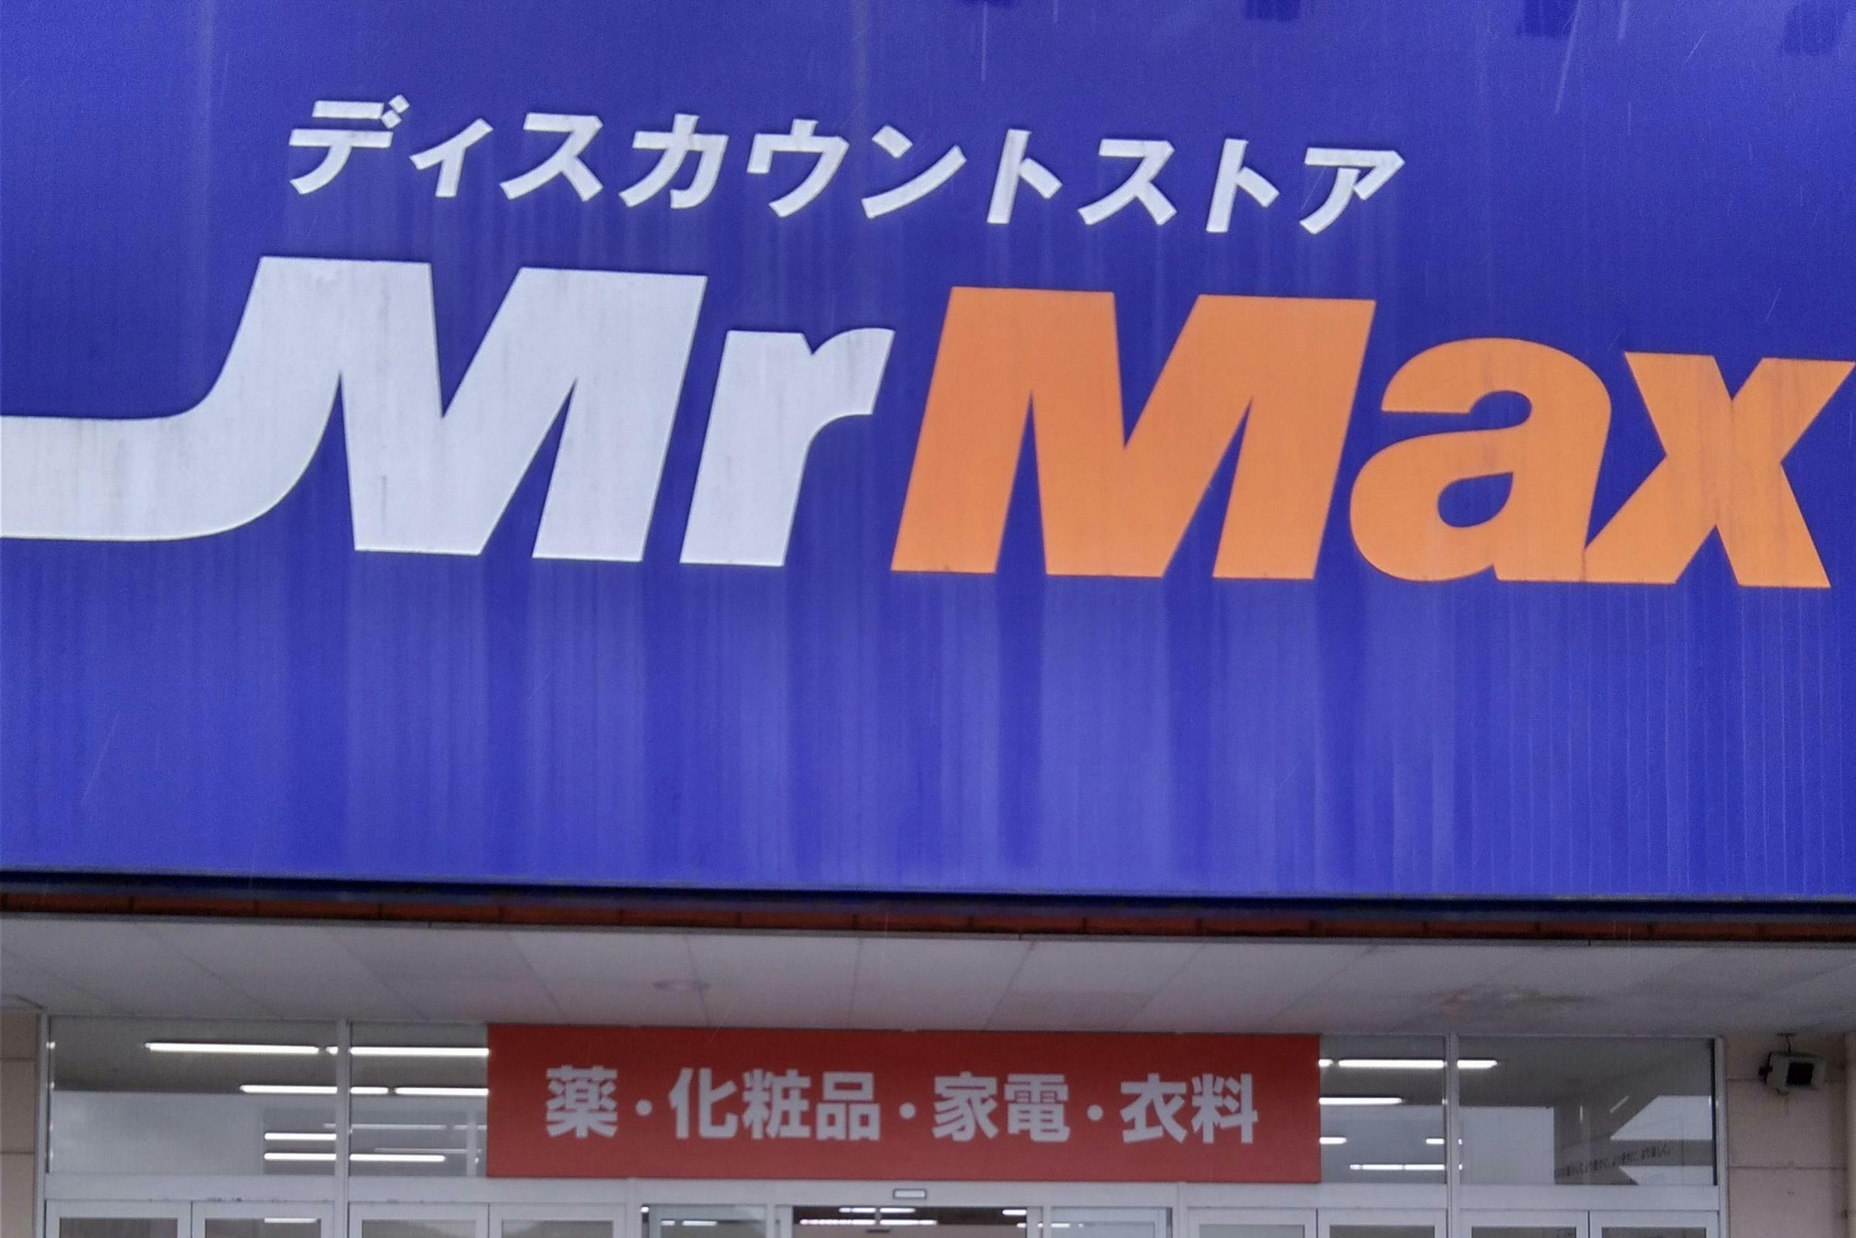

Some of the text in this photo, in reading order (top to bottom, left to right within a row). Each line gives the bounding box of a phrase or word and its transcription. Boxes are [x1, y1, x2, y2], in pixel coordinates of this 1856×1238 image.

[288, 96, 1405, 236] ディスカウントストア
[0, 256, 1856, 592] MrMax
[544, 1063, 1260, 1146] 薬・化粧品・家電・衣料
